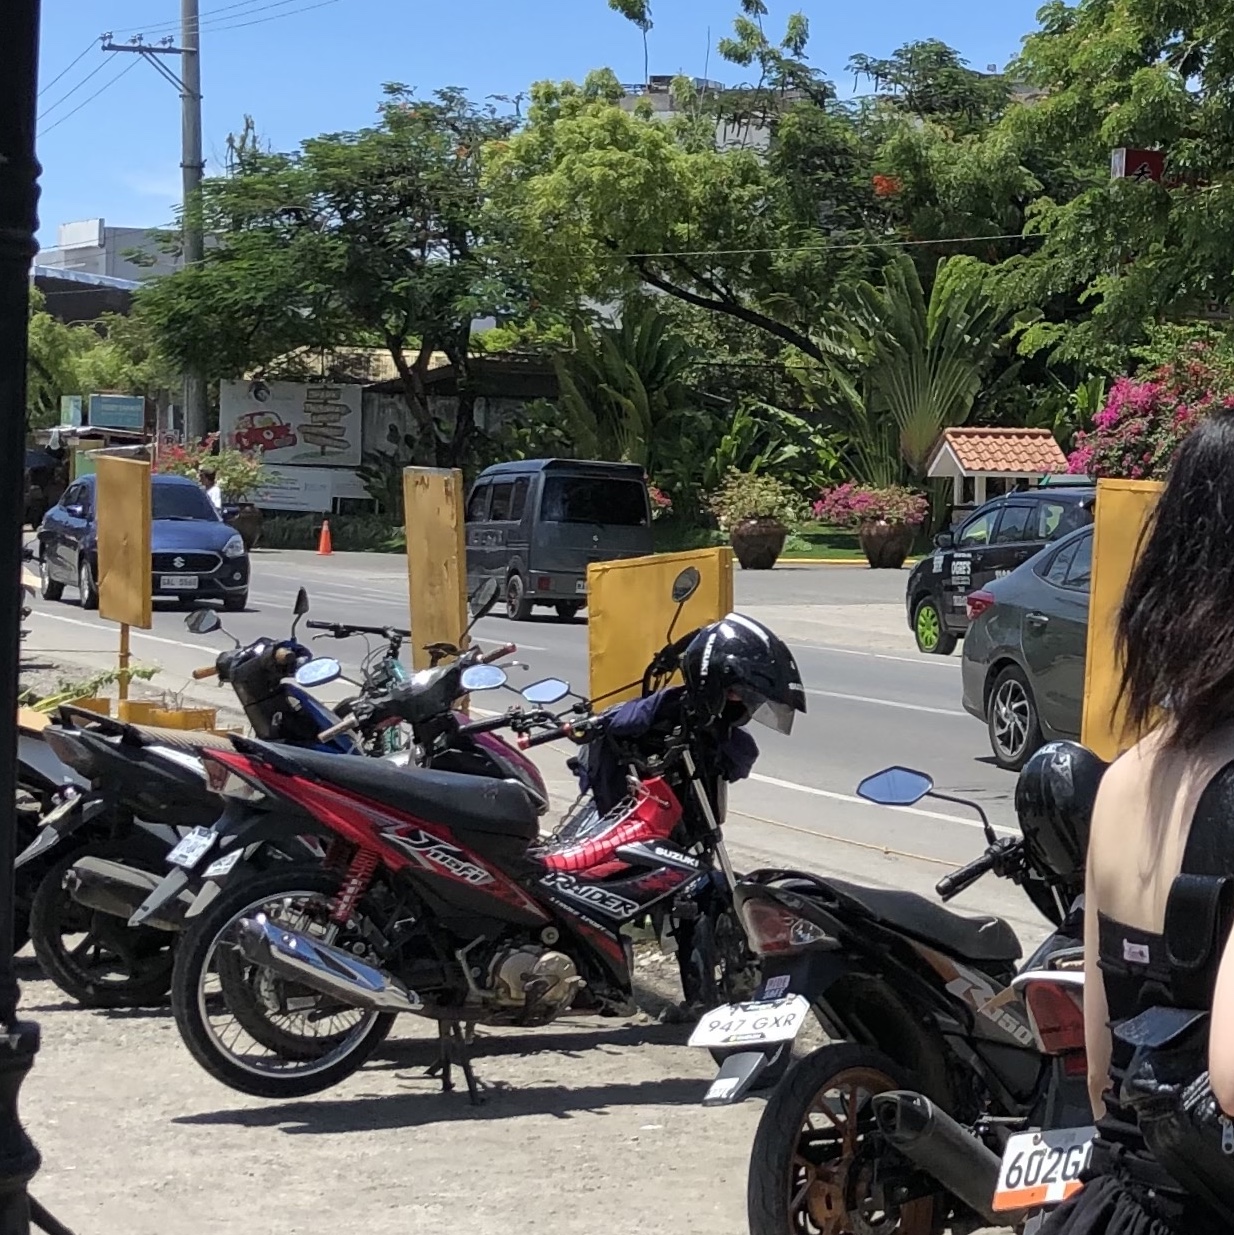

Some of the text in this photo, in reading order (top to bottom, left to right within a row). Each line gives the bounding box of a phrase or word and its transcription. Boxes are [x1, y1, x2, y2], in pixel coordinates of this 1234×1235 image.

[655, 846, 700, 868] SUZUKI
[539, 872, 641, 918] RAIDER
[708, 1013, 797, 1032] 947 GXR
